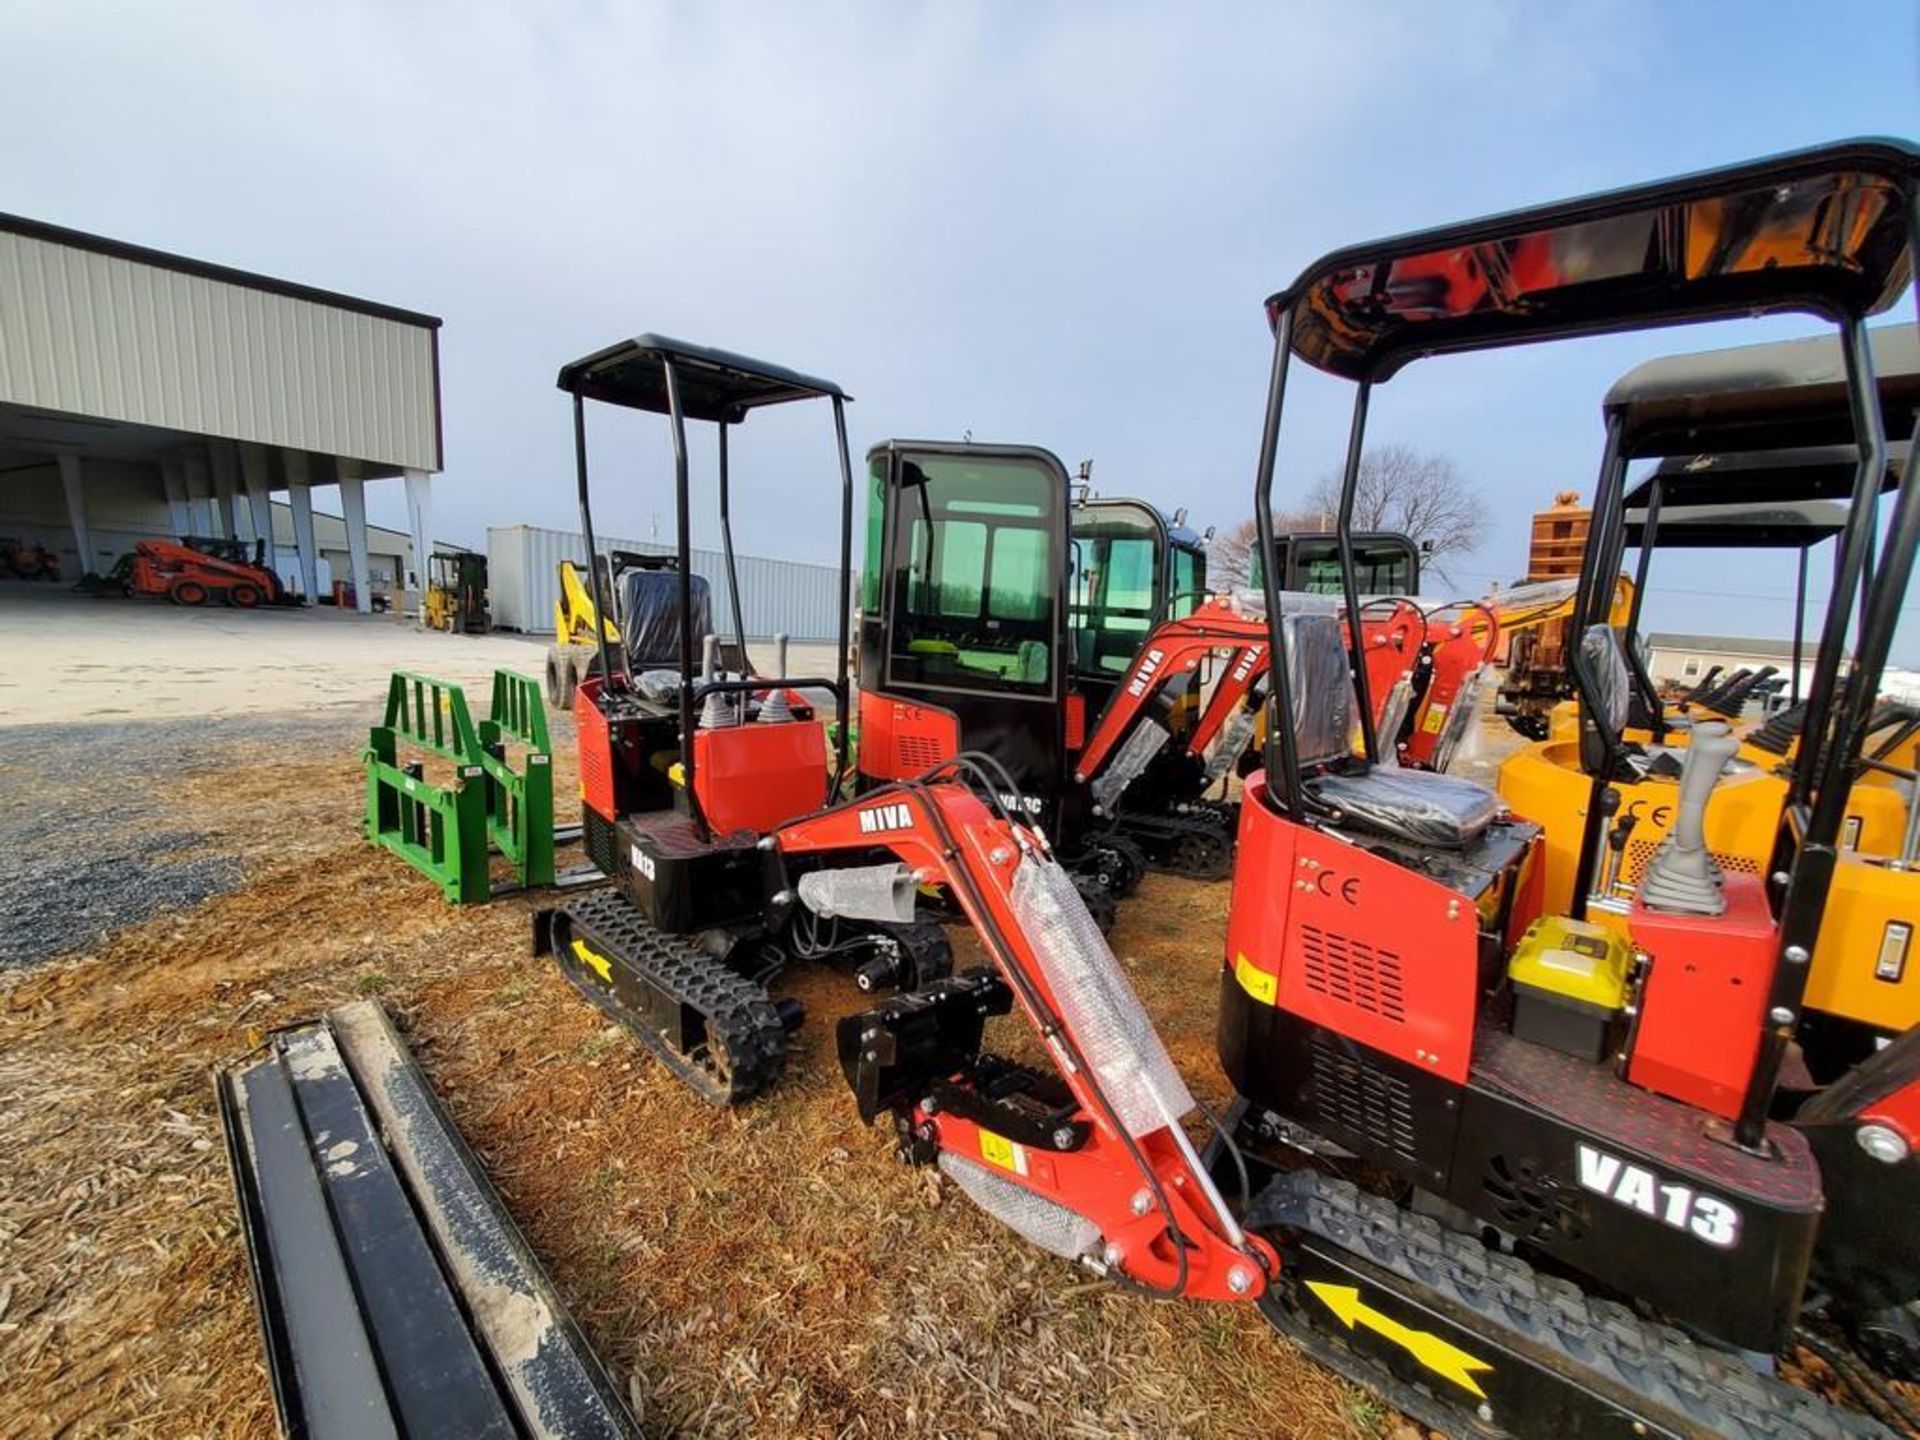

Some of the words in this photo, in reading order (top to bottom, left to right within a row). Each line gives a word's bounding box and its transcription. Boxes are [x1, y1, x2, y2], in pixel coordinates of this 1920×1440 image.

[1128, 649, 1164, 697] MIVA
[859, 803, 913, 833] MIVA
[1577, 1144, 1740, 1246] VA13
